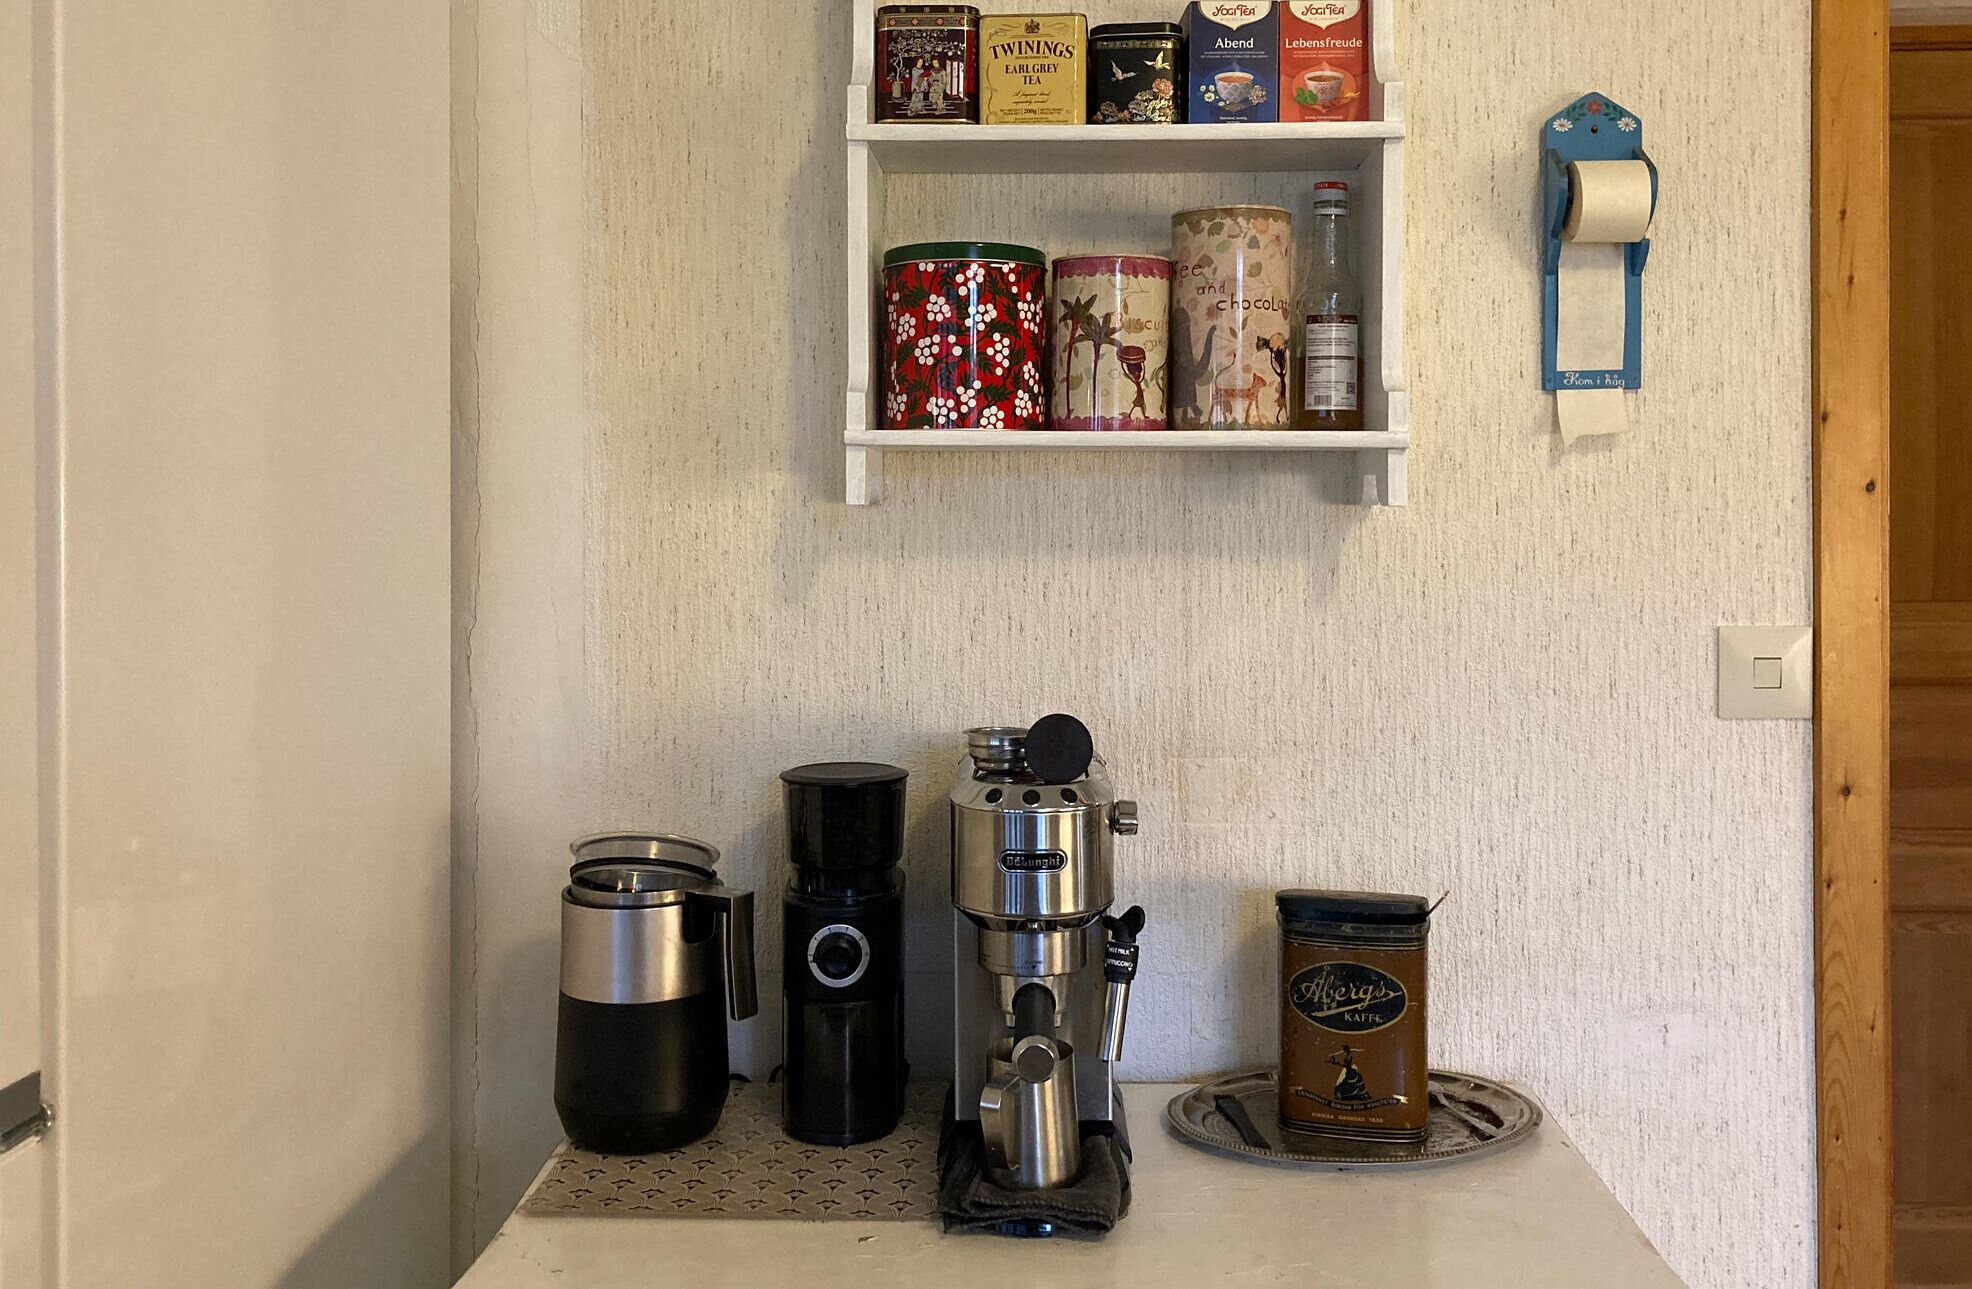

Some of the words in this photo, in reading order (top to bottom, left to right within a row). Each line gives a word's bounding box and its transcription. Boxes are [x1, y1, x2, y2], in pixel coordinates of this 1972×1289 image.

[1212, 4, 1237, 16] YOGI
[1236, 4, 1255, 16] TEA
[1301, 4, 1325, 15] YOGI
[1325, 4, 1344, 15] TEA
[1214, 37, 1254, 48] Abend
[1285, 37, 1363, 48] Lebensfreude
[989, 40, 1075, 60] TWININGS
[1005, 63, 1031, 74] EARL
[1032, 62, 1059, 74] GREY
[1022, 75, 1041, 85] TEA
[1195, 281, 1226, 295] and
[1563, 371, 1594, 385] Kom
[1605, 373, 1625, 388] håg
[1344, 1012, 1383, 1023] KAFFE
